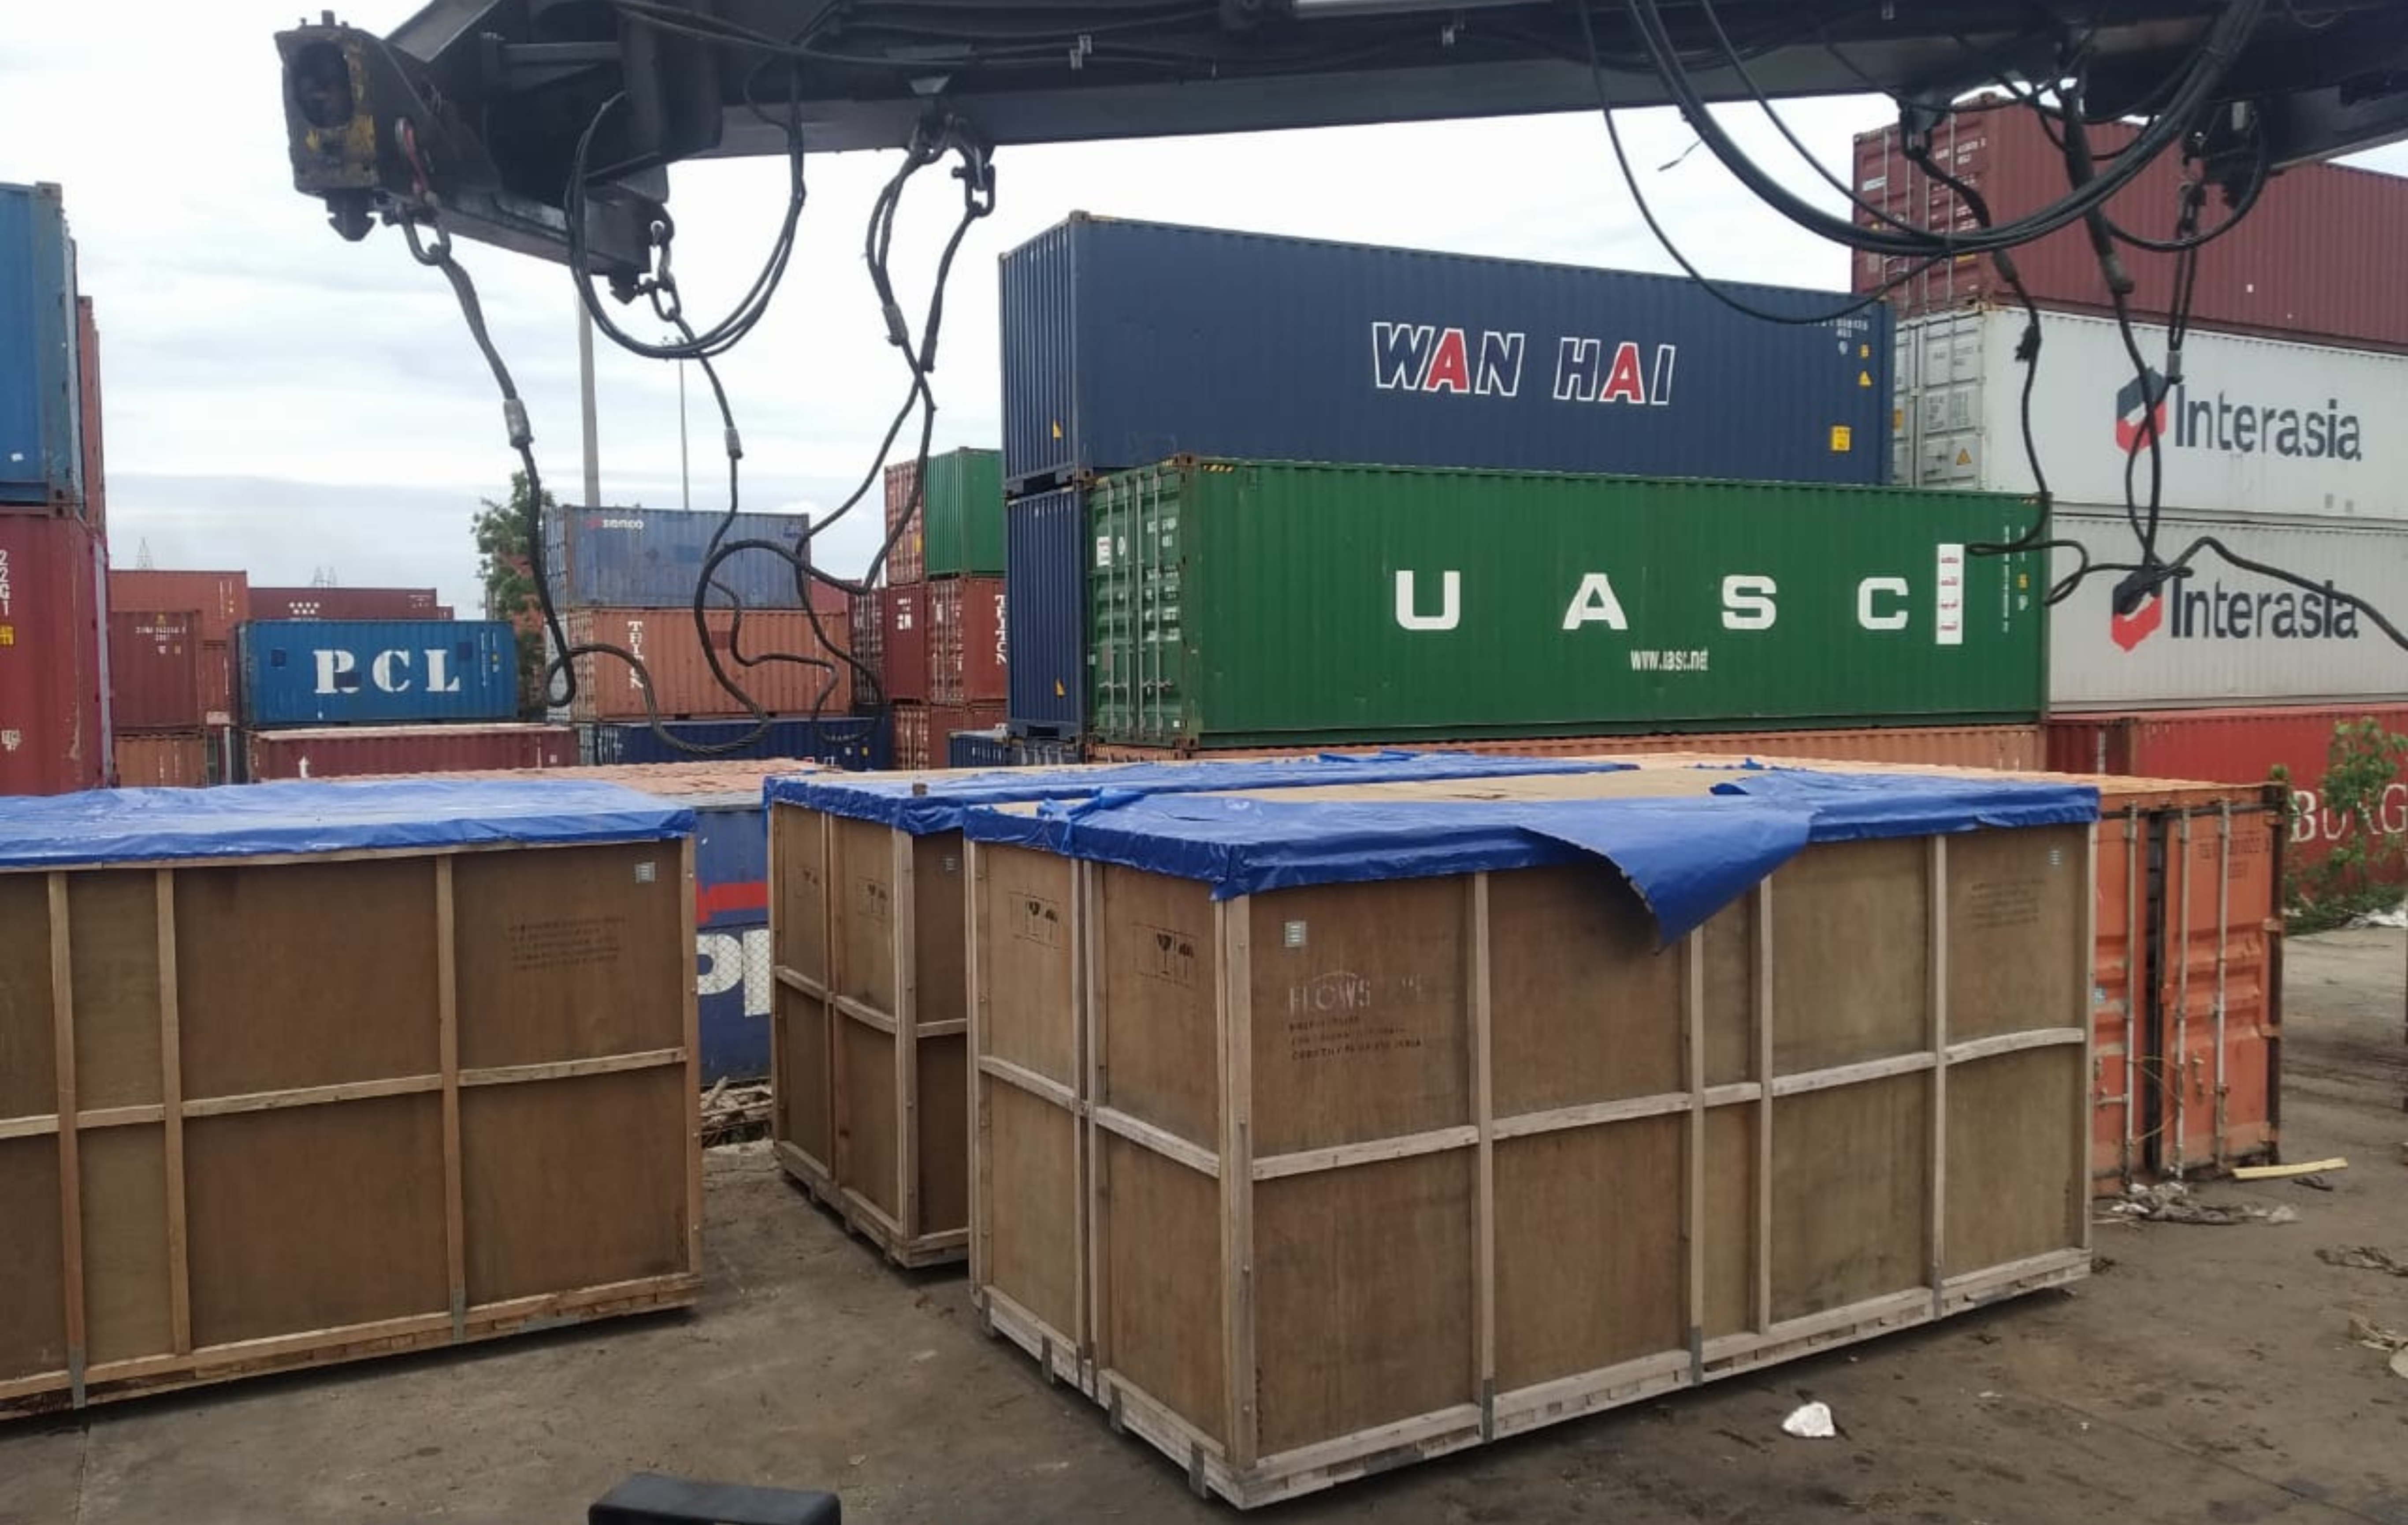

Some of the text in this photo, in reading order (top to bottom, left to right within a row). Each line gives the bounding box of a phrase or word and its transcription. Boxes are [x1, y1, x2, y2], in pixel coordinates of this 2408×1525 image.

[1372, 322, 1676, 405] WAN HAI
[2175, 384, 2362, 461] Interasia
[2171, 577, 2359, 639] Interasia
